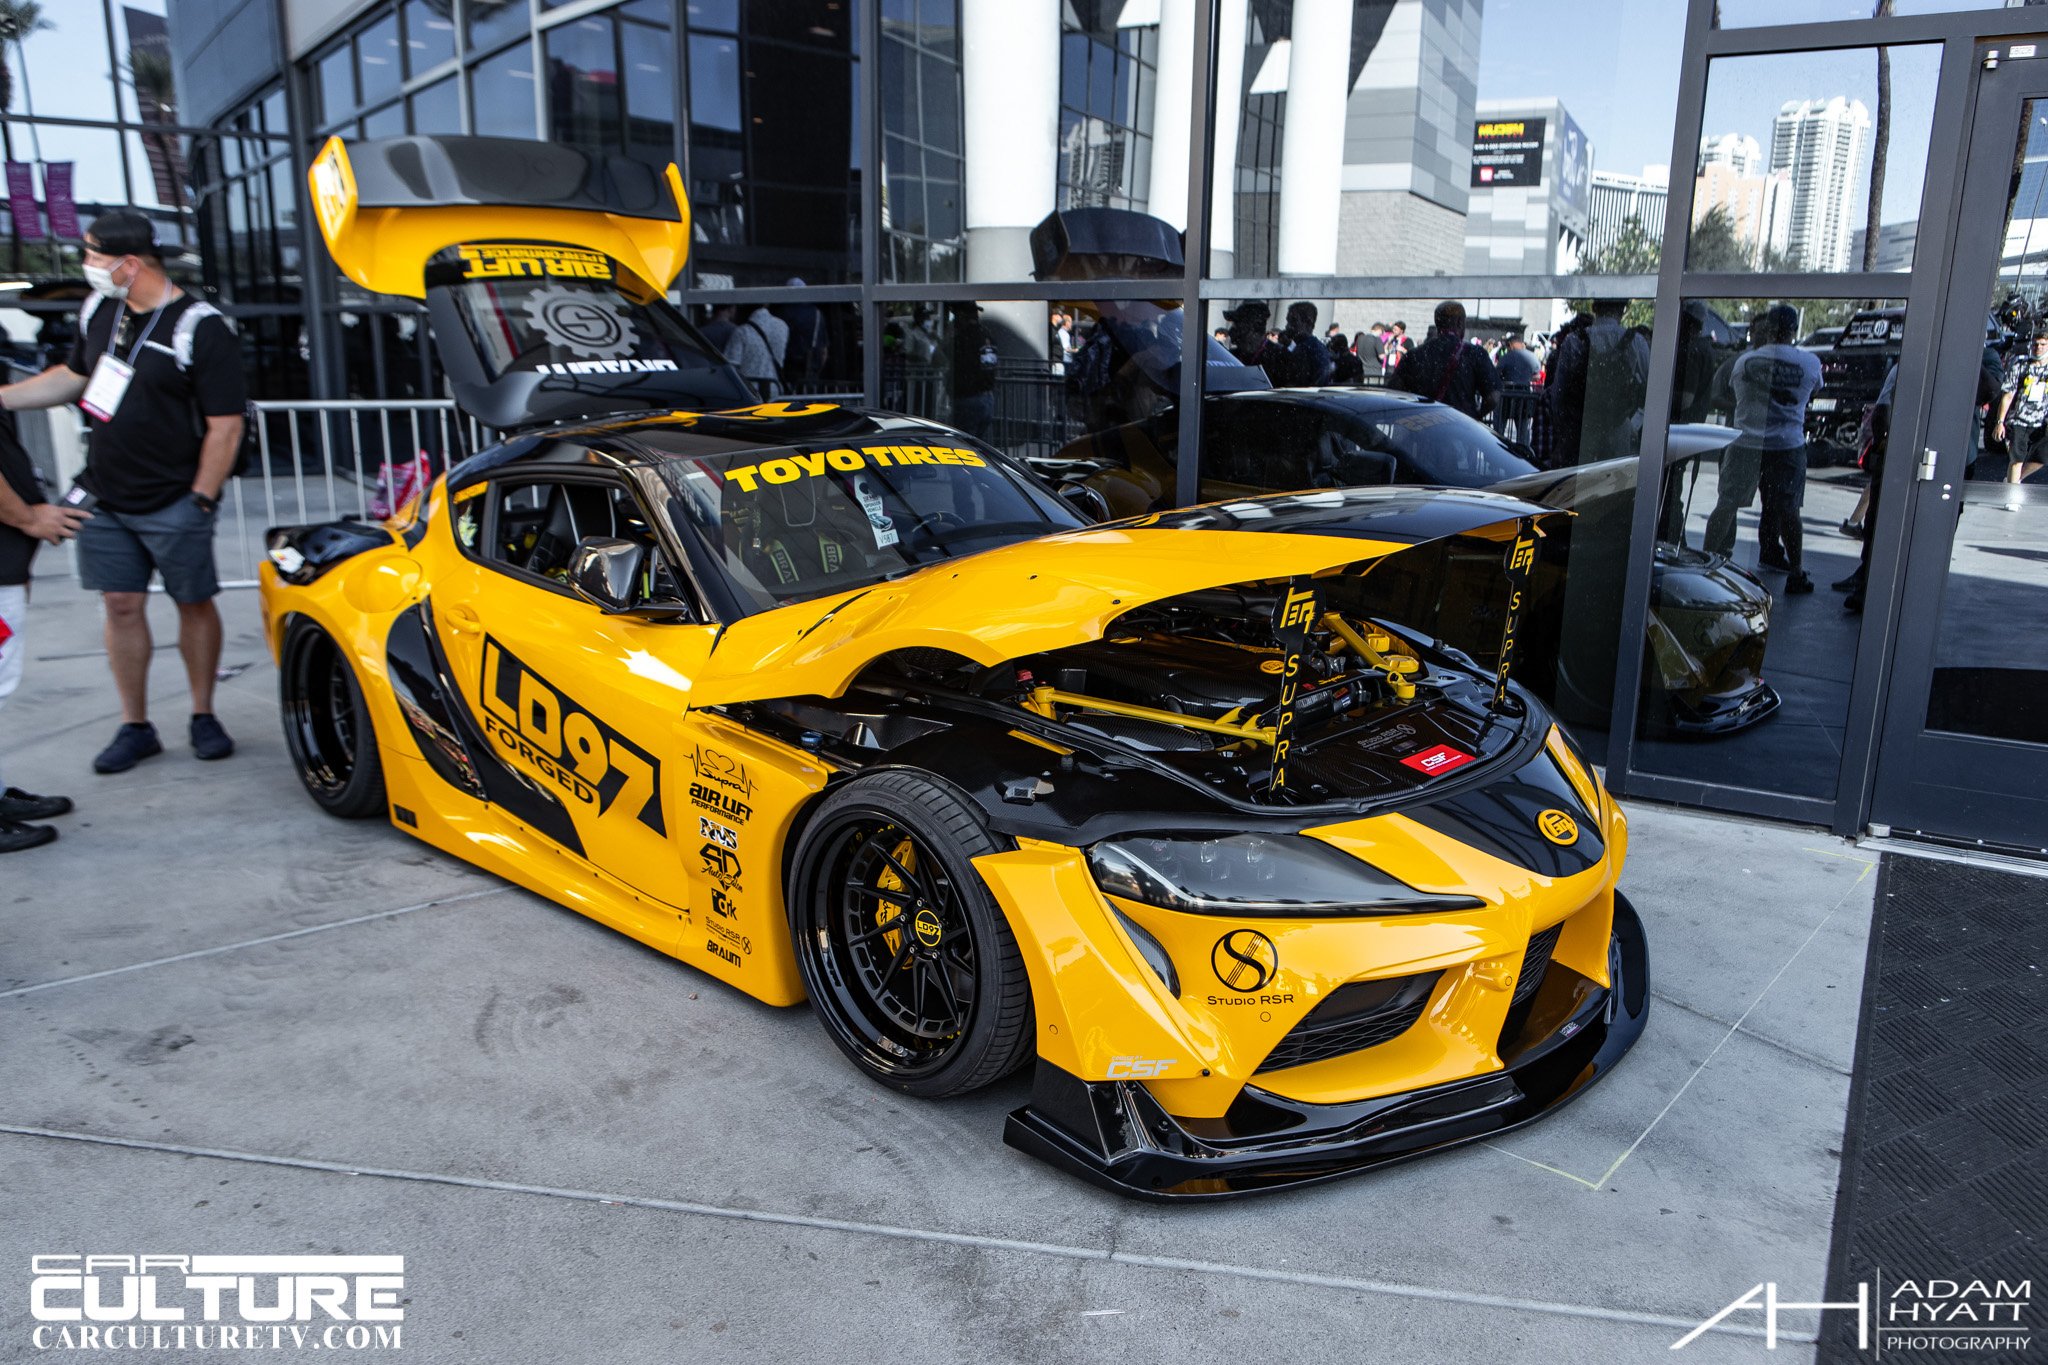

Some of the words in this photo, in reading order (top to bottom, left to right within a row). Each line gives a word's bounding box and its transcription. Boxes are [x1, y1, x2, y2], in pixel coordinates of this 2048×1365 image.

[724, 449, 866, 493] TOYO
[861, 445, 987, 468] TIRES
[482, 636, 661, 832] LD97
[1271, 653, 1300, 792] SUPRA
[484, 715, 594, 804] FORGED
[1420, 752, 1446, 767] CSF
[699, 767, 747, 794] Supra
[722, 795, 753, 821] LIFT
[1260, 994, 1294, 1005] RSR
[1106, 1059, 1178, 1078] CSF
